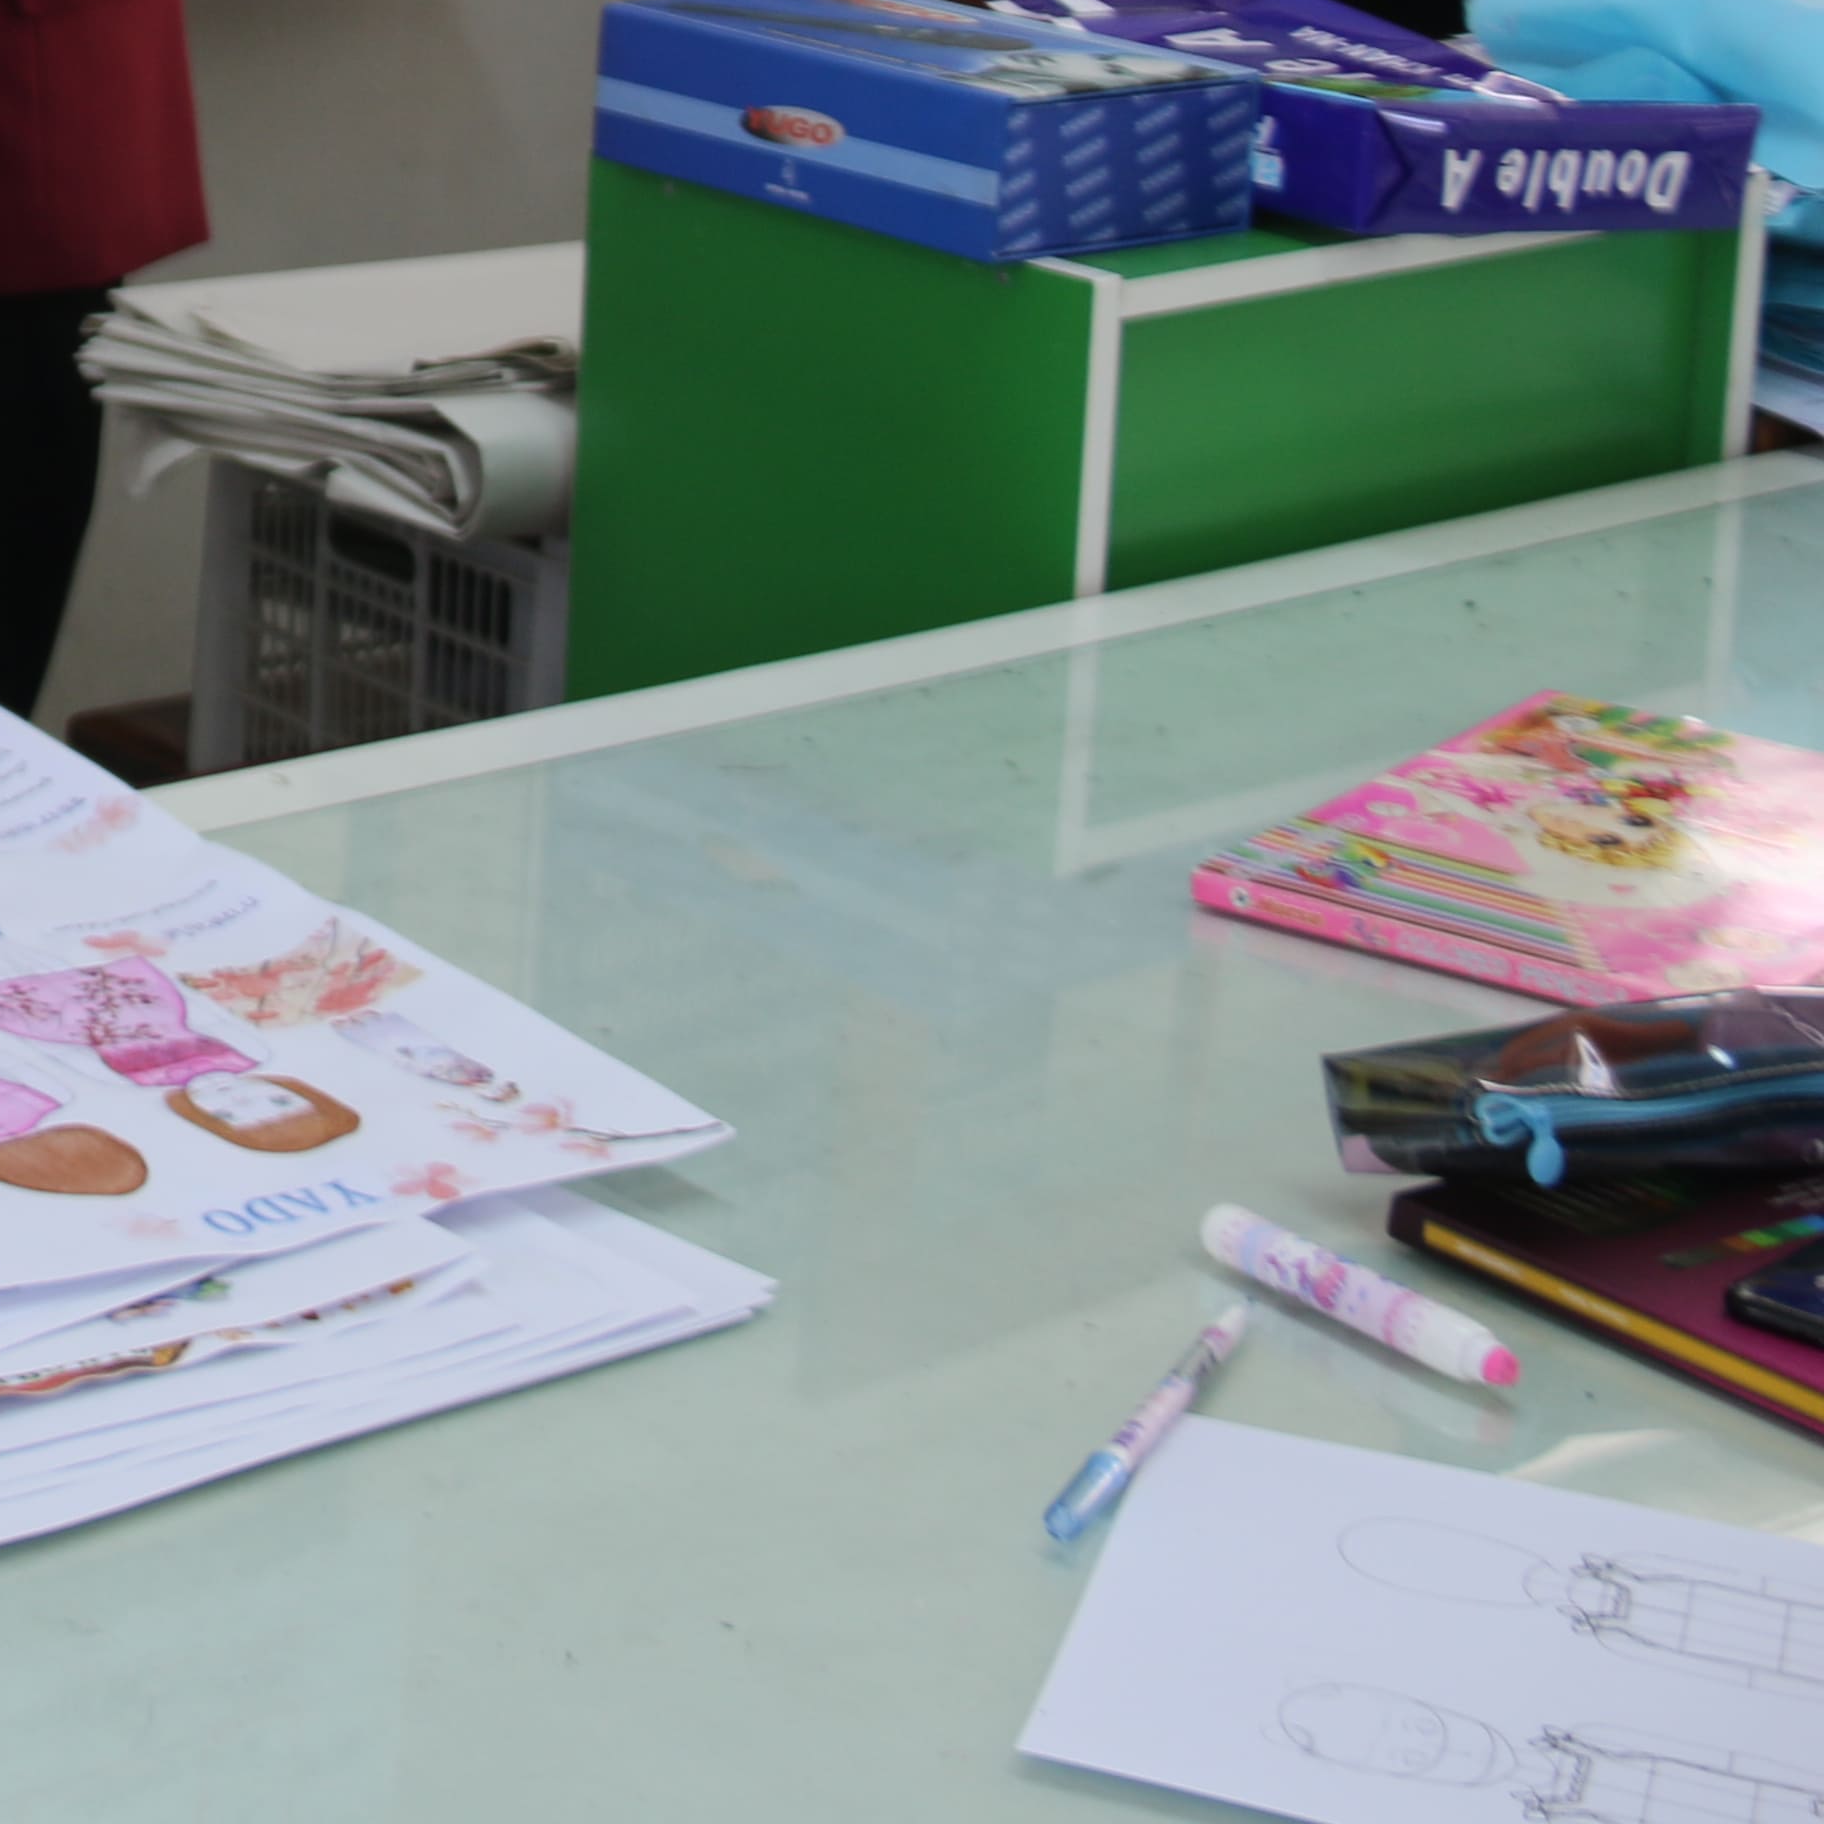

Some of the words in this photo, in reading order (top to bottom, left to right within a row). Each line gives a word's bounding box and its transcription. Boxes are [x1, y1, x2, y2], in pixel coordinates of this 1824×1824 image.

[1441, 147, 1484, 211] A
[1495, 147, 1691, 214] Double
[200, 1180, 381, 1238] YADO
